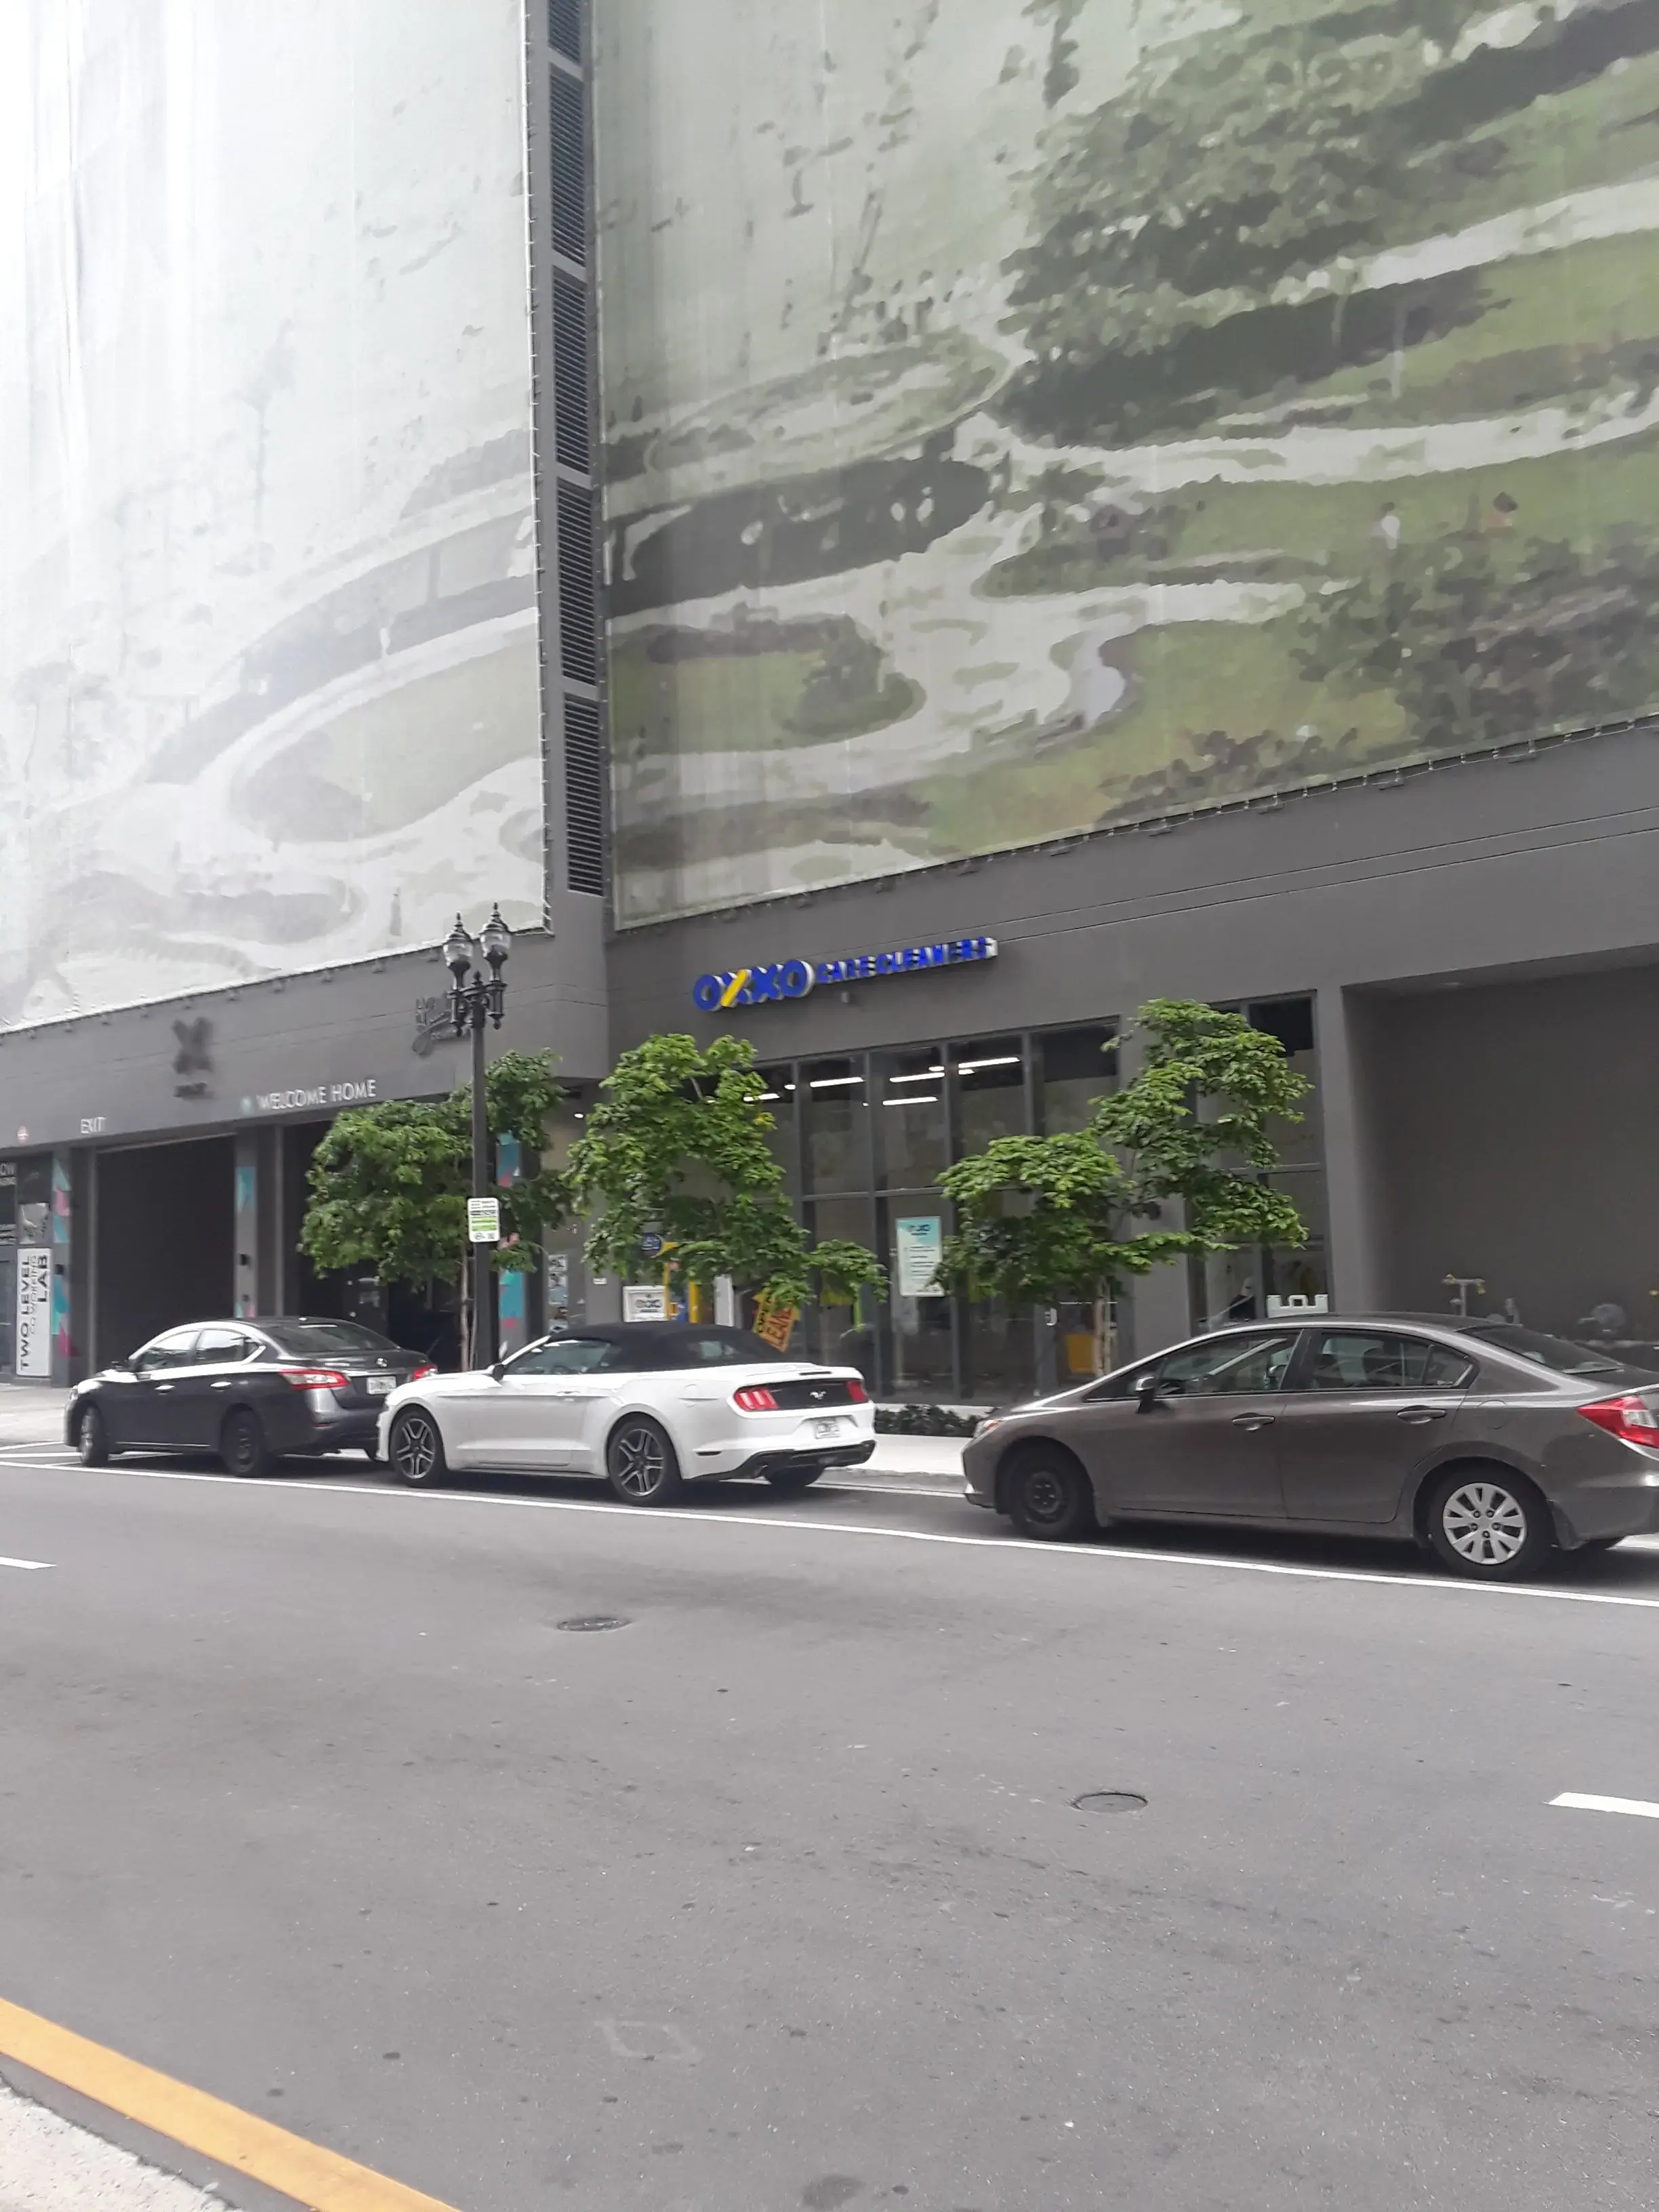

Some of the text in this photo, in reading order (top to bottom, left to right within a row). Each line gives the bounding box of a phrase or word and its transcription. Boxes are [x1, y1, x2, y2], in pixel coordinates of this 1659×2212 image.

[693, 936, 998, 1012] OXXO CARE CLEANERS
[256, 1079, 377, 1110] WELCOME HOME
[81, 1116, 106, 1134] EXIT
[37, 1254, 47, 1303] LAB
[20, 1255, 30, 1370] TWO LEVEL
